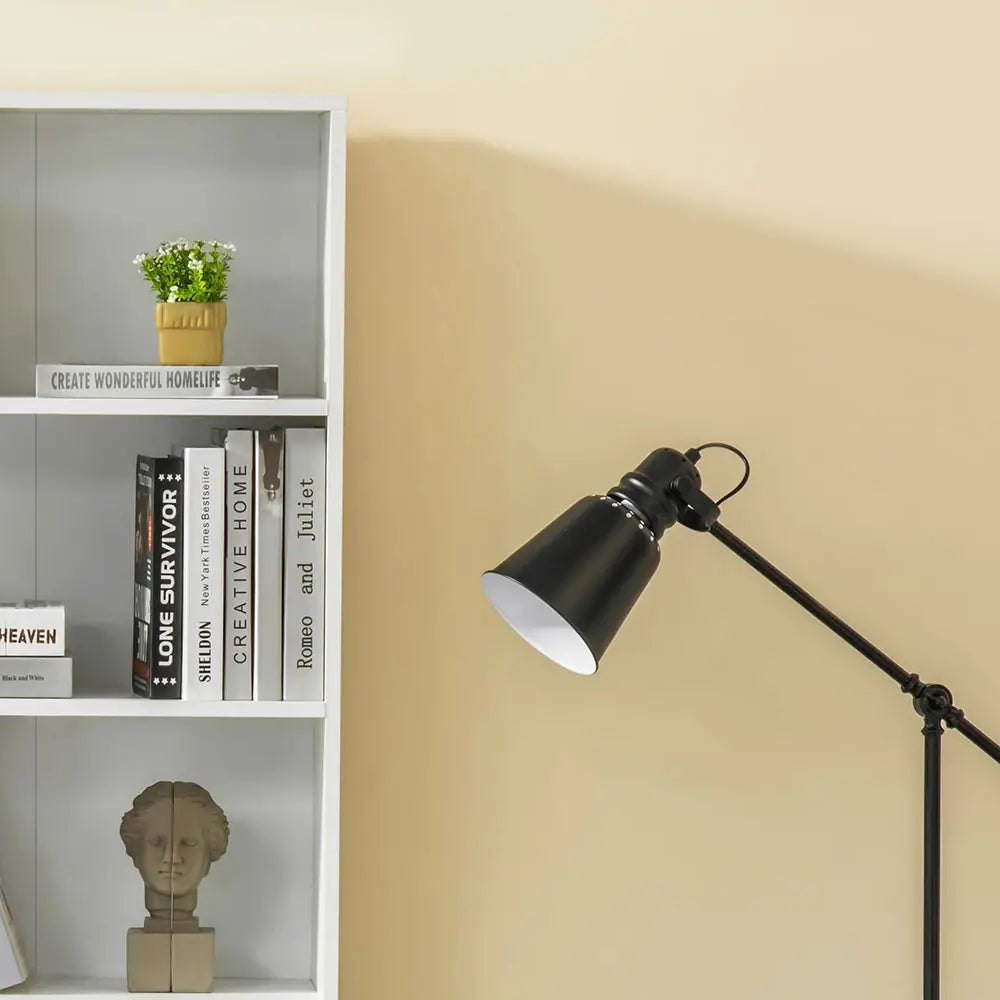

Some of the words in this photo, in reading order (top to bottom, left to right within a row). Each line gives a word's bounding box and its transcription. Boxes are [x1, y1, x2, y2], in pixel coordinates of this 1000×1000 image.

[51, 372, 90, 390] CREATE
[95, 371, 162, 389] WONDERFUL
[166, 370, 220, 388] HOMELIFE
[234, 465, 247, 530] HOME
[298, 478, 316, 540] Juliet
[161, 489, 176, 604] SURVIVOR
[201, 522, 210, 554] Times
[201, 583, 209, 606] New
[234, 546, 247, 664] CREATIVE
[298, 563, 312, 594] and
[158, 612, 174, 666] LONE
[199, 621, 211, 683] SHELDON
[297, 616, 312, 669] Romeo
